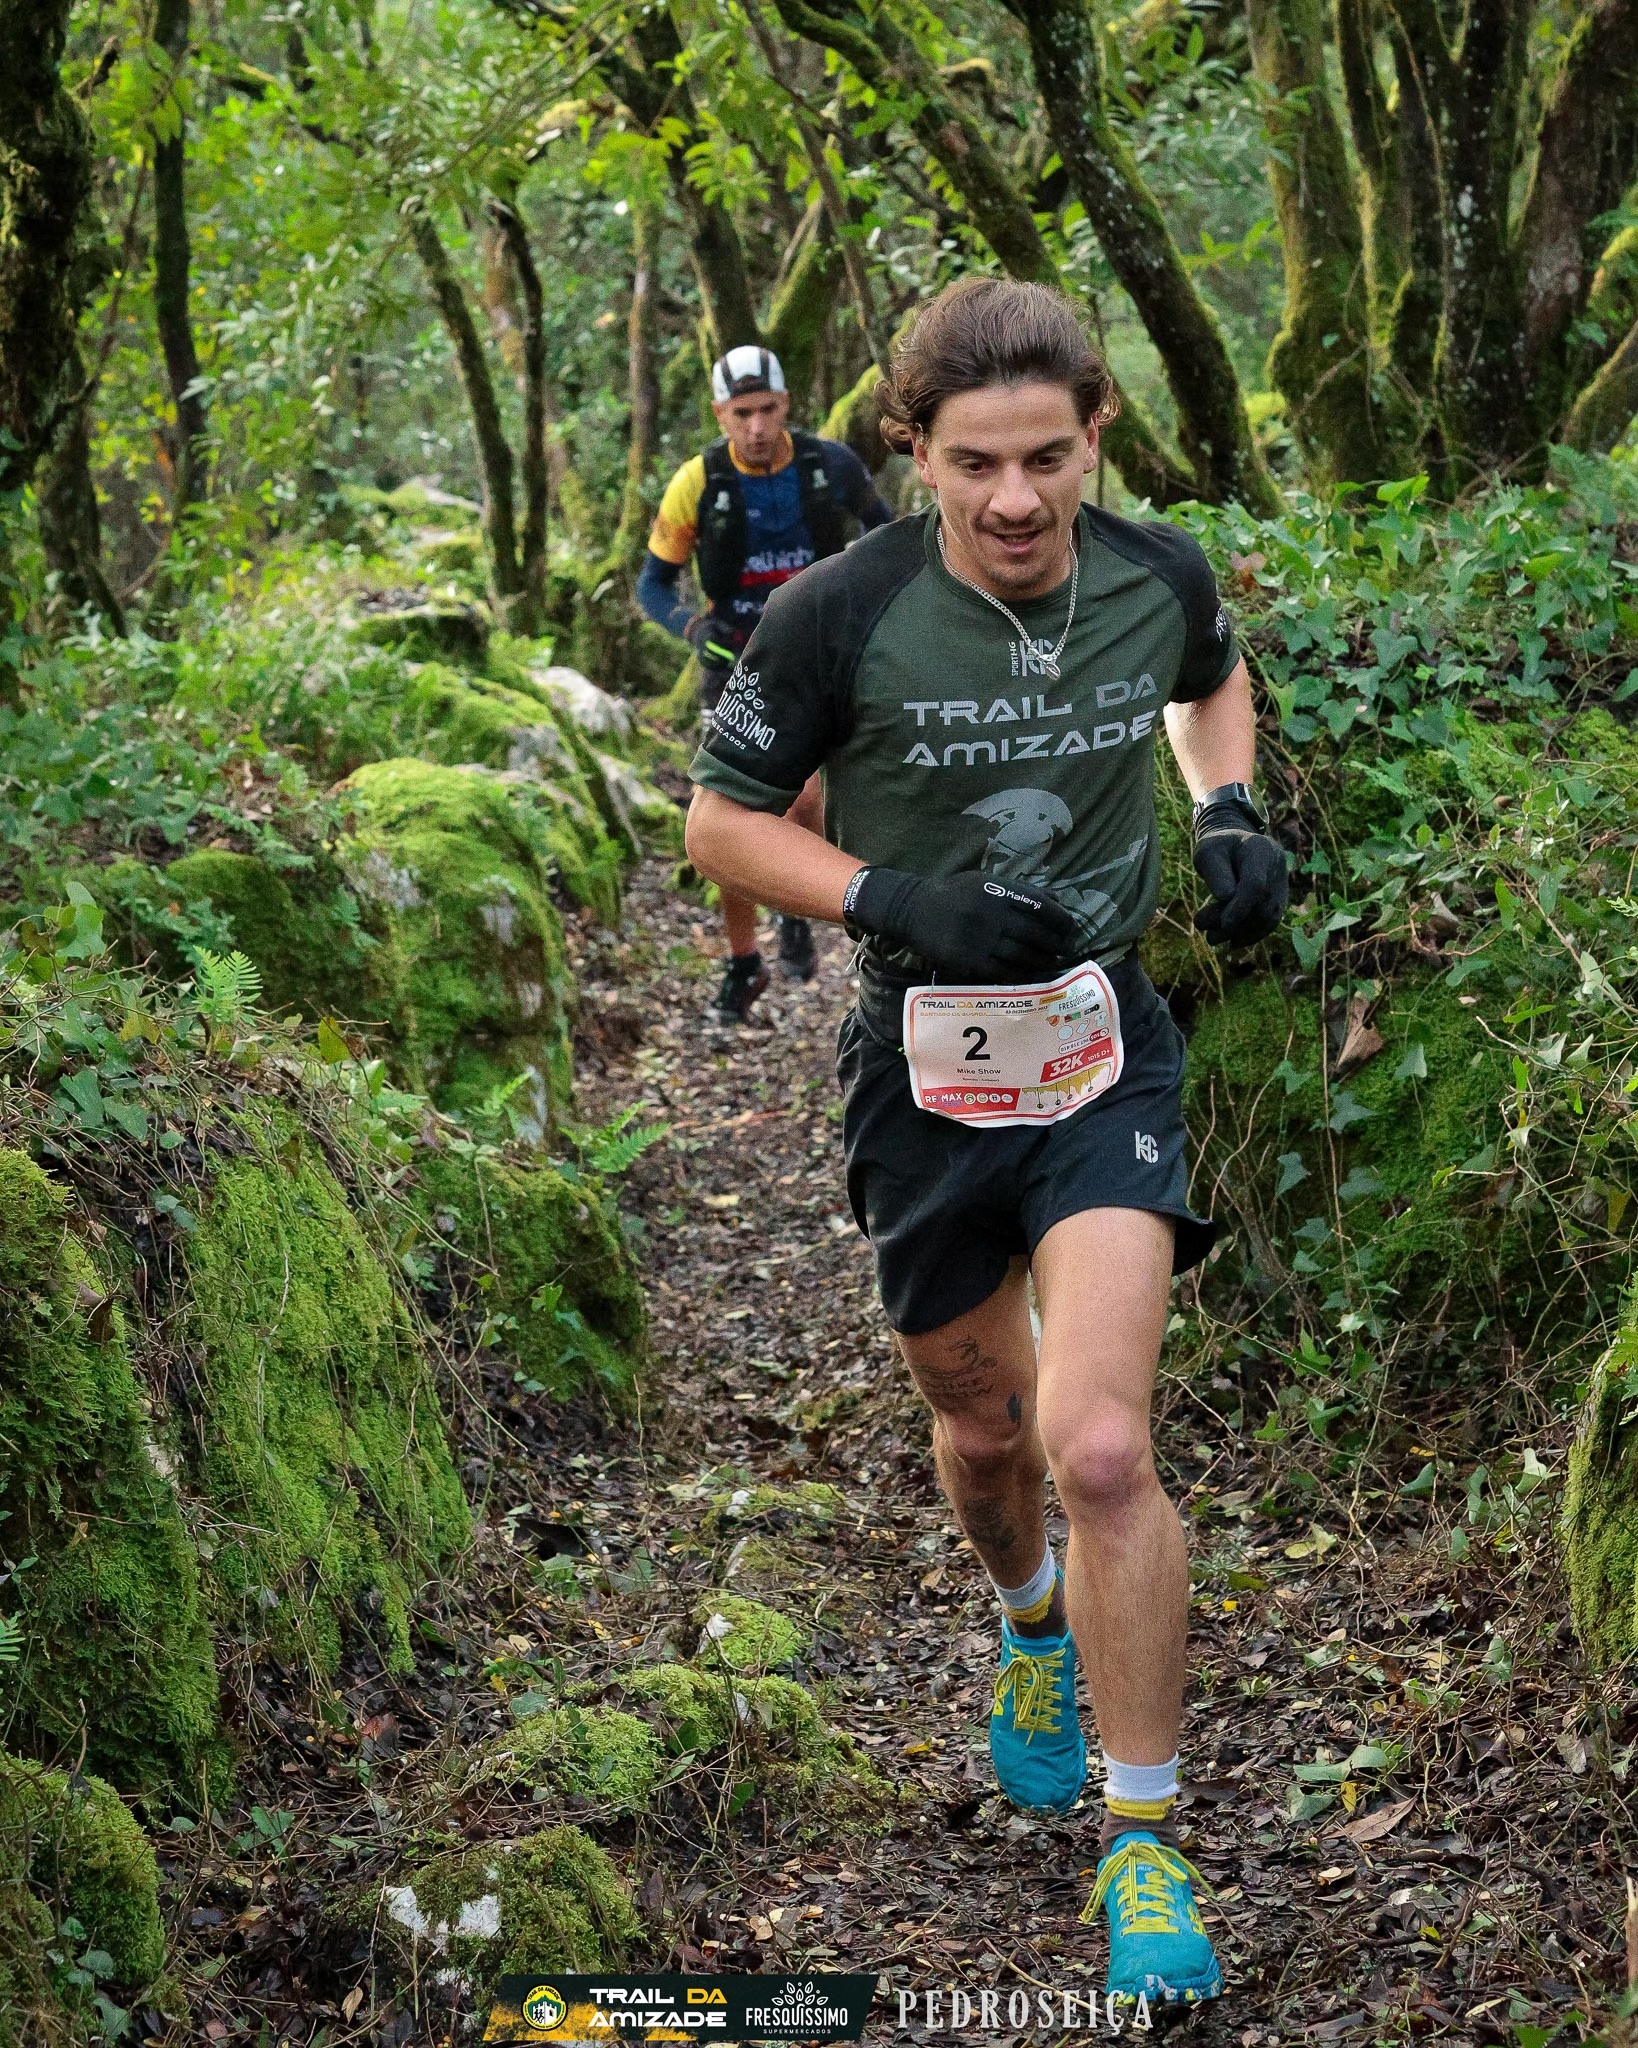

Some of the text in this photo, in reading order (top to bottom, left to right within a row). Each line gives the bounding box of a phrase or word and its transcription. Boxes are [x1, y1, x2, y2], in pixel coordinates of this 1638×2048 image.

[903, 673, 1157, 727] TRAIL DA
[902, 710, 1157, 767] AMIZADE
[844, 872, 863, 912] TRAIL DA
[1006, 890, 1042, 910] Kalenji
[975, 1000, 1033, 1008] AMIZADE
[962, 1026, 991, 1061] 2
[1049, 1051, 1085, 1078] 32K
